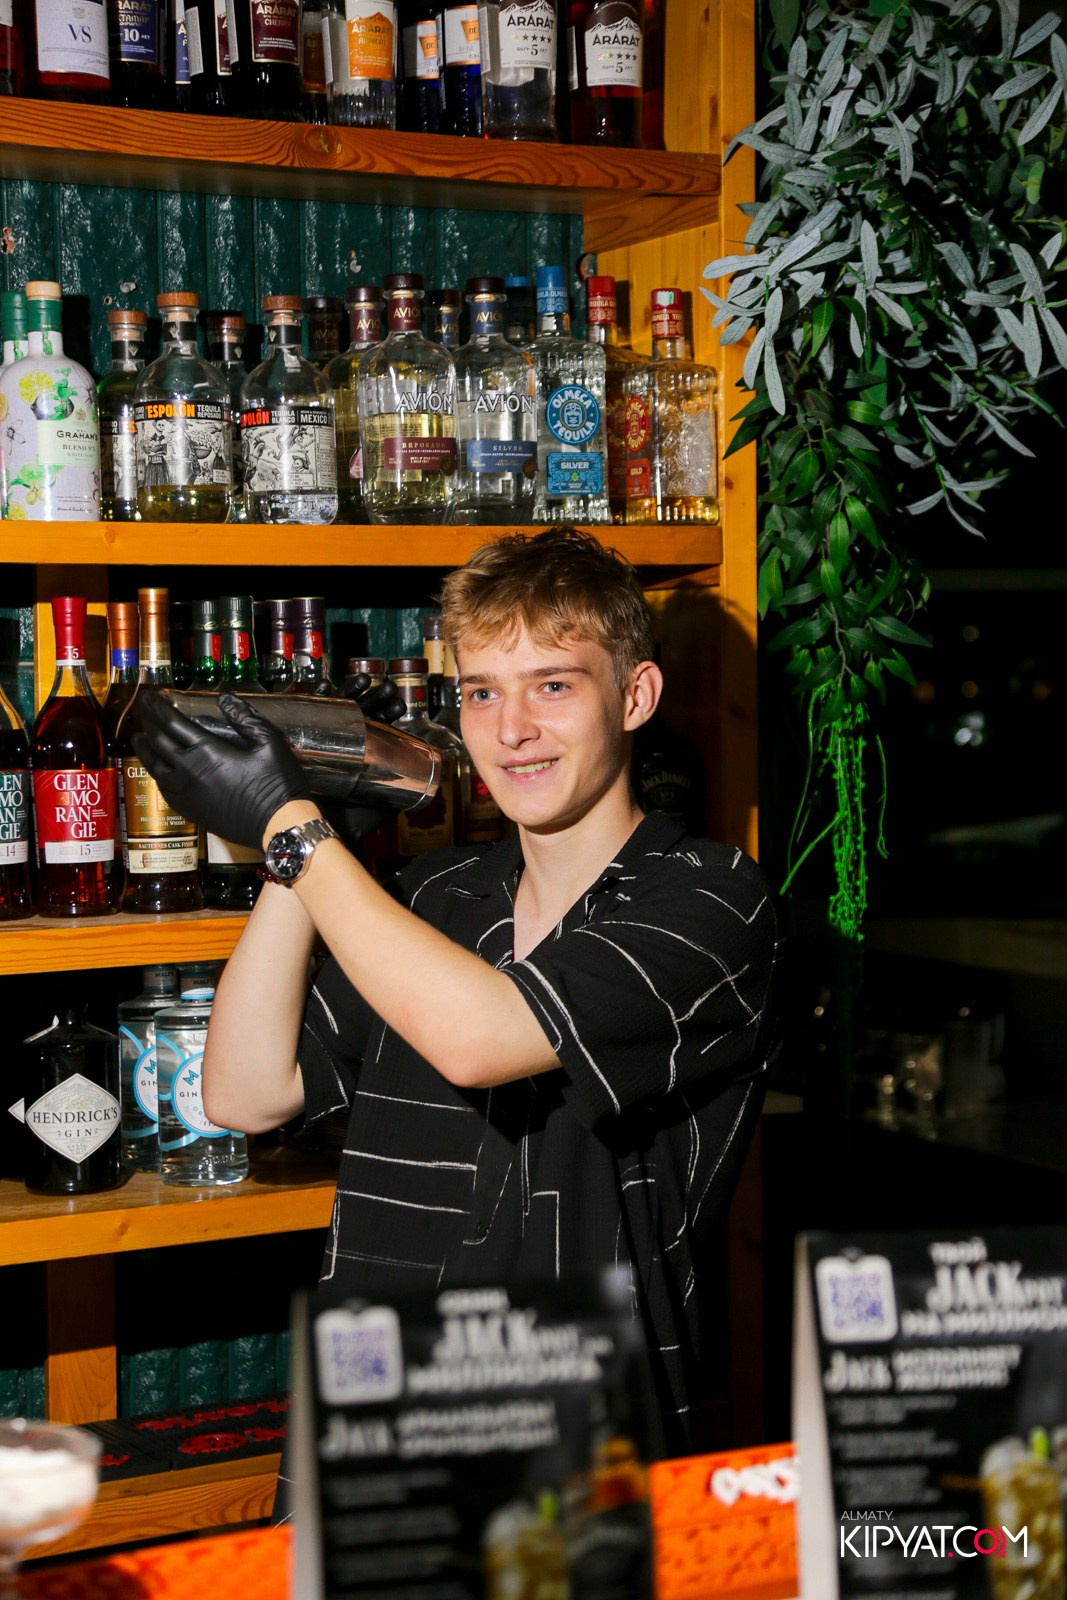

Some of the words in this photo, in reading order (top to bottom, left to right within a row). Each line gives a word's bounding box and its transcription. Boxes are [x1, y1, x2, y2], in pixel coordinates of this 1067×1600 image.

[256, 3, 297, 17] ARARAT
[507, 14, 554, 29] ARARAT
[67, 23, 92, 44] VS
[124, 28, 140, 42] 10
[592, 33, 640, 47] ARARAT
[530, 44, 539, 56] 5
[616, 62, 624, 73] 5
[474, 391, 533, 414] AVIÓN
[552, 389, 594, 410] OLMECA
[197, 404, 221, 412] TEQUILA
[197, 411, 222, 419] REPOSADO
[271, 409, 295, 417] TEQUILA
[271, 416, 296, 424] BLANCO
[300, 413, 328, 424] MEXICO
[56, 430, 98, 441] GRAHAM'S
[552, 418, 596, 442] TEQUILA
[560, 461, 590, 469] SILVER
[630, 466, 643, 476] GOLD
[54, 773, 99, 791] GLEN
[70, 789, 100, 806] MO
[55, 806, 91, 822] RAN
[0, 822, 20, 839] GIE
[70, 821, 97, 838] GIE
[6, 845, 16, 857] 14
[80, 844, 91, 856] 15
[33, 1106, 119, 1124] HENDRICK'S
[64, 1128, 93, 1138] GIN
